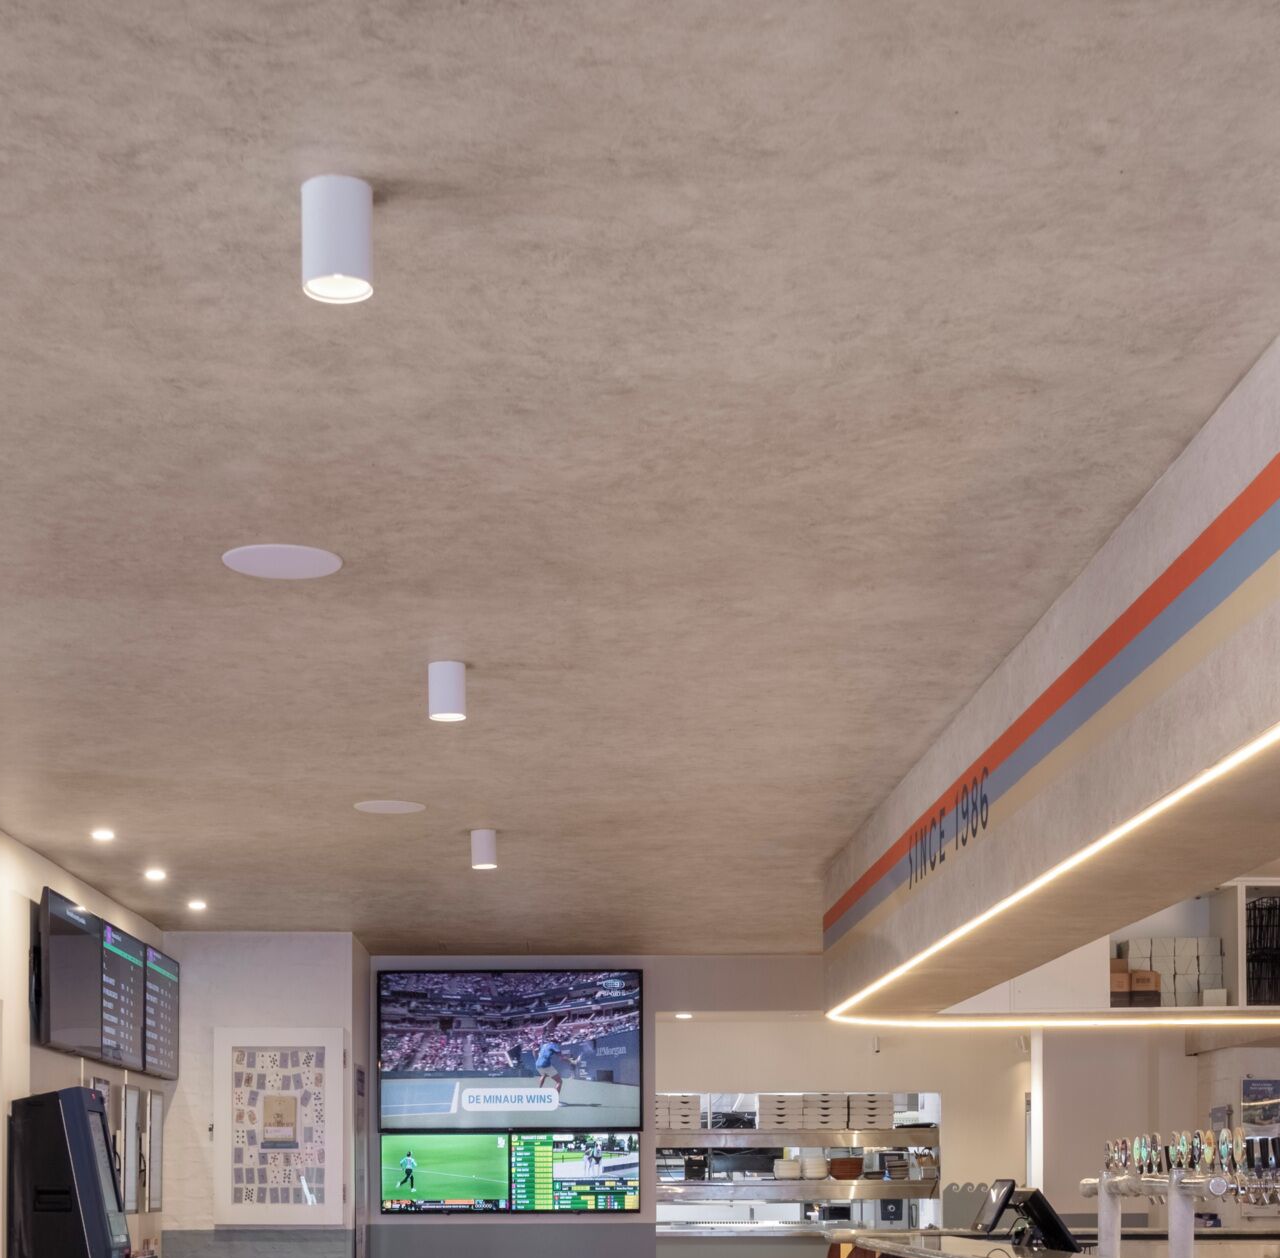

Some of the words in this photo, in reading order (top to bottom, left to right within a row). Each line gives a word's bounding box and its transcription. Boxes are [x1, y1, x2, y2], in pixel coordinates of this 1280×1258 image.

[908, 807, 946, 890] SINCE
[955, 767, 989, 851] 1986
[468, 1094, 483, 1104] DE
[483, 1094, 524, 1104] MINAUR
[525, 1094, 553, 1104] WINS
